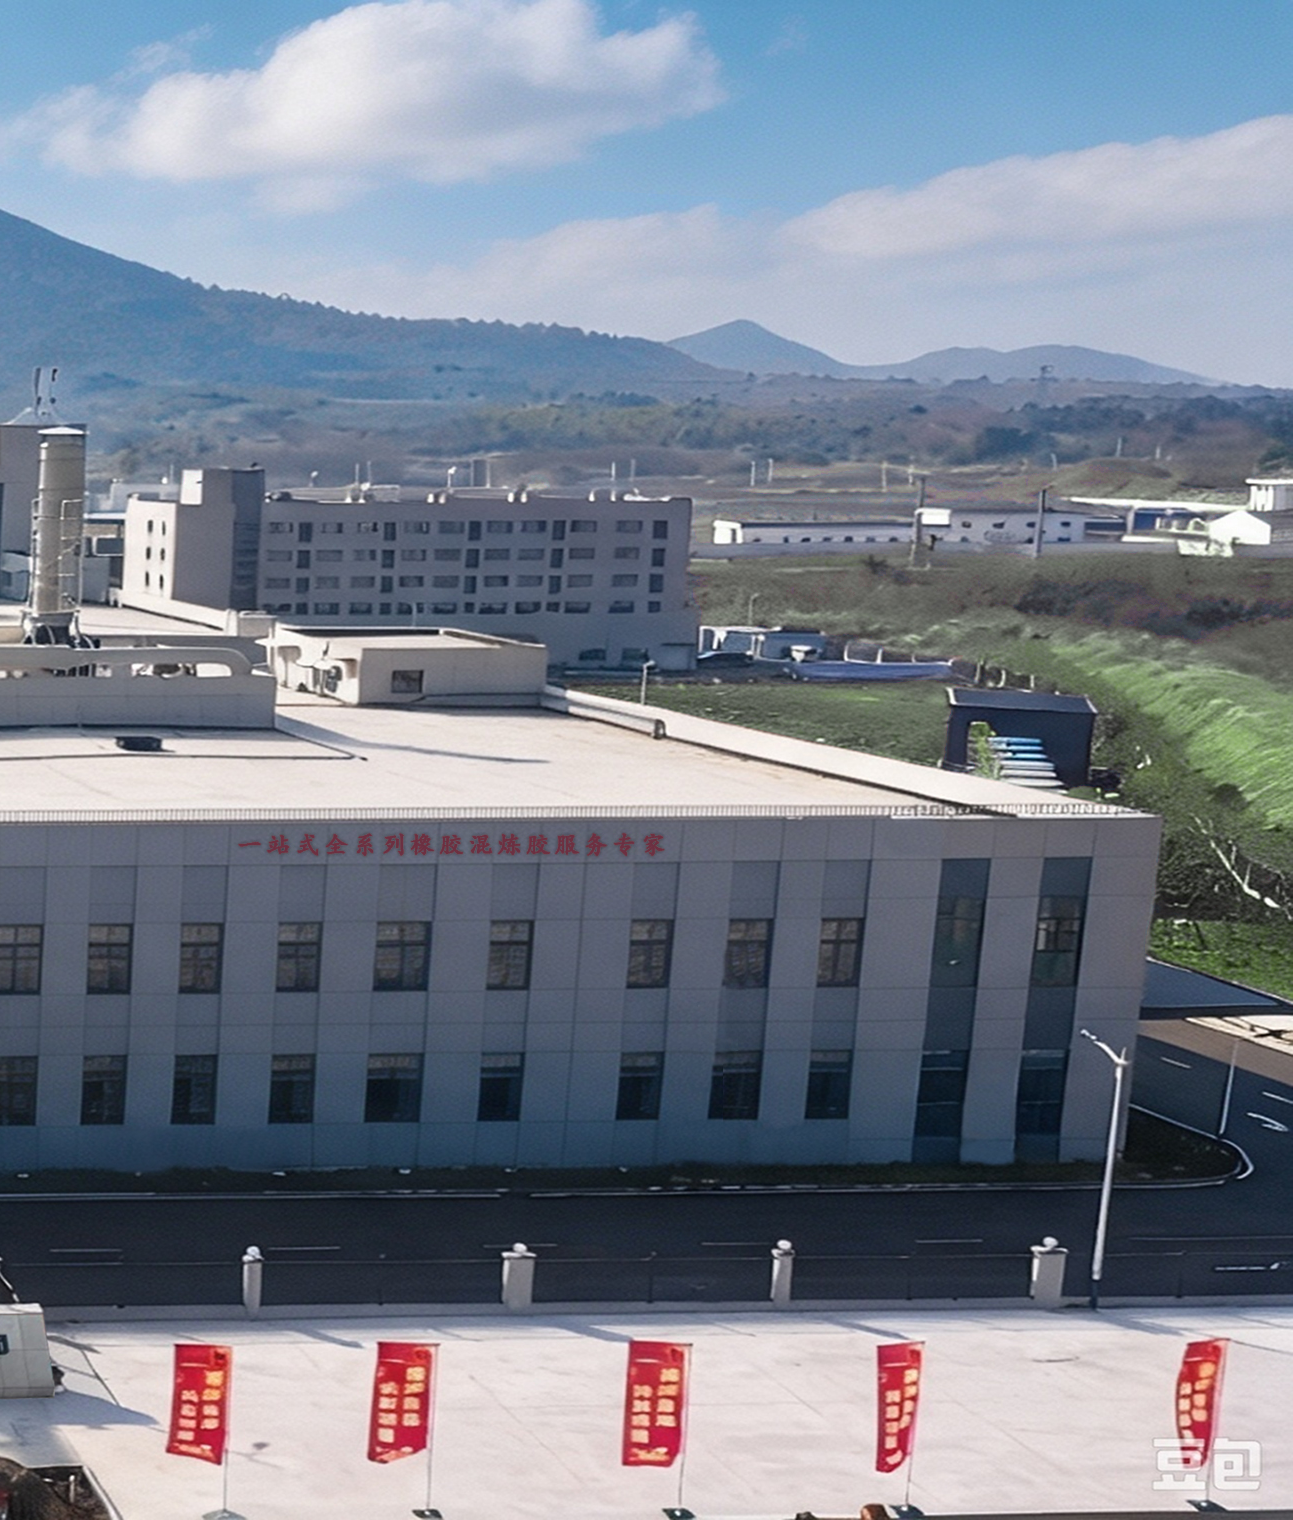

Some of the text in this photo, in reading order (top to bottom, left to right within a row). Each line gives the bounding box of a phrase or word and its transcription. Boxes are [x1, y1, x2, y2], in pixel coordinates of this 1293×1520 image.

[238, 832, 666, 857] 一站式全系列橡胶混炼胶服务专家
